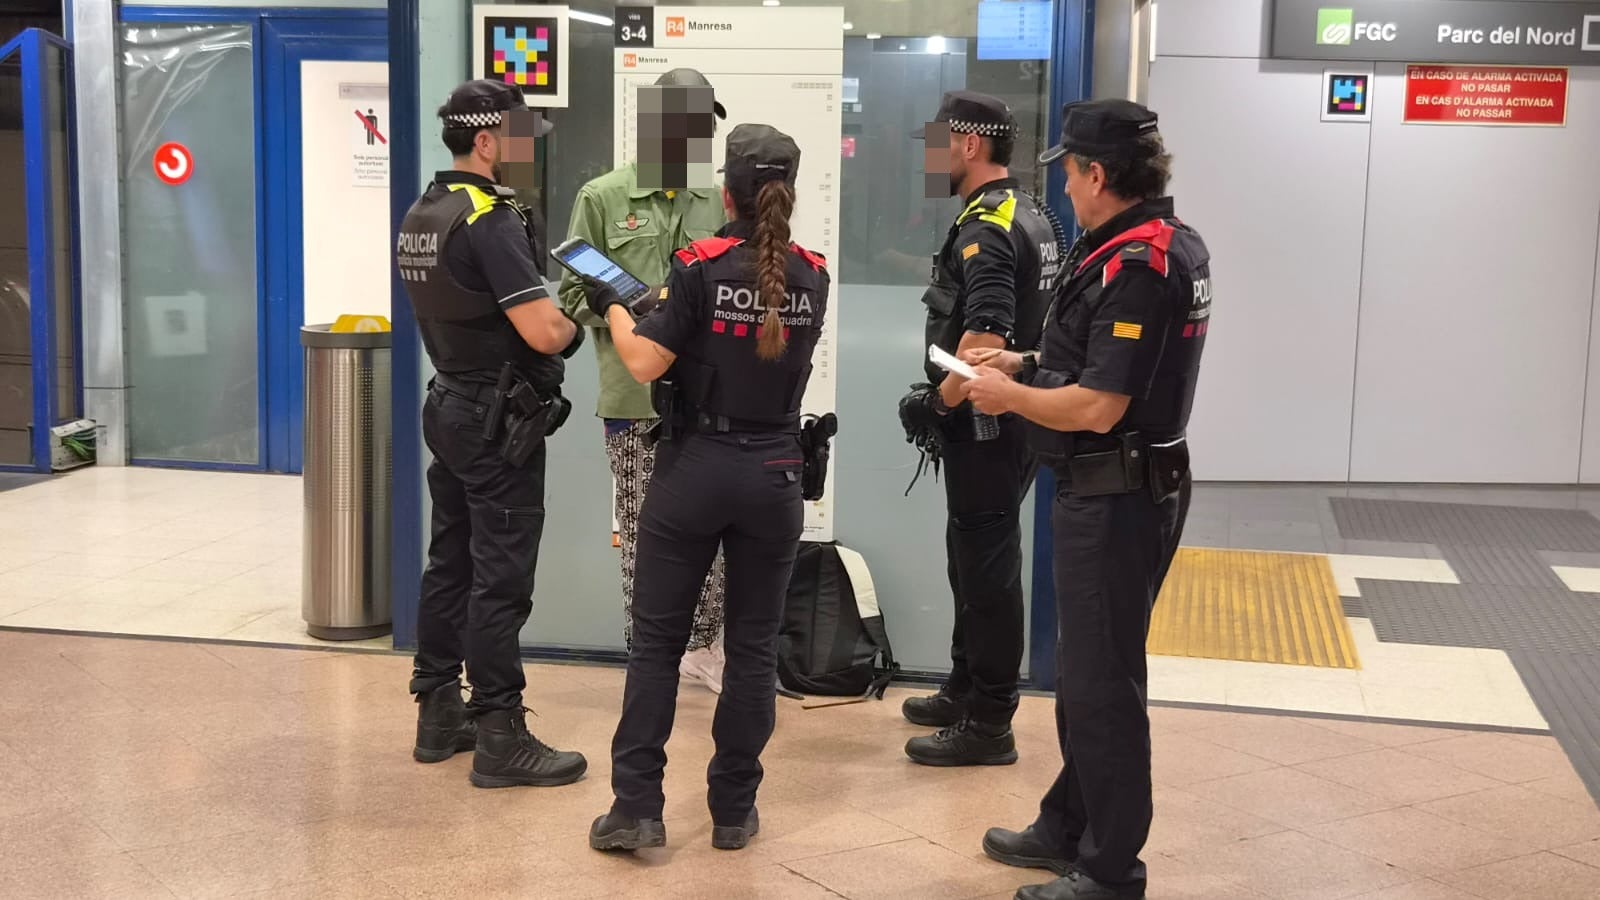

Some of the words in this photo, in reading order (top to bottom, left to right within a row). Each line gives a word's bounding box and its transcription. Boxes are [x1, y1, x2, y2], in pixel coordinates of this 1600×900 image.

[667, 20, 684, 32] R4
[688, 21, 732, 31] Manresa
[1354, 23, 1397, 41] FGC
[621, 26, 647, 41] 3-4
[1437, 24, 1483, 44] Parc
[1489, 26, 1520, 44] del
[1526, 27, 1576, 46] Nord
[624, 56, 636, 64] R4
[638, 56, 668, 64] Manresa
[1410, 71, 1424, 80] EN
[1426, 71, 1453, 80] CASO
[1455, 72, 1469, 80] DE
[1471, 72, 1512, 81] ALARMA
[1514, 73, 1562, 82] ACTIVADA
[1461, 83, 1475, 92] NO
[1477, 84, 1511, 93] PASAR
[1415, 96, 1429, 105] EN
[1431, 96, 1452, 105] CAS
[1453, 97, 1503, 106] D'ALARMA
[1505, 98, 1554, 107] ACTIVADA
[1456, 109, 1470, 117] NO
[1472, 109, 1512, 118] PASSAR
[397, 232, 438, 253] POLICIA
[716, 285, 812, 313] POLCIA
[714, 309, 755, 322] mossos
[757, 311, 812, 326] d'quadra
